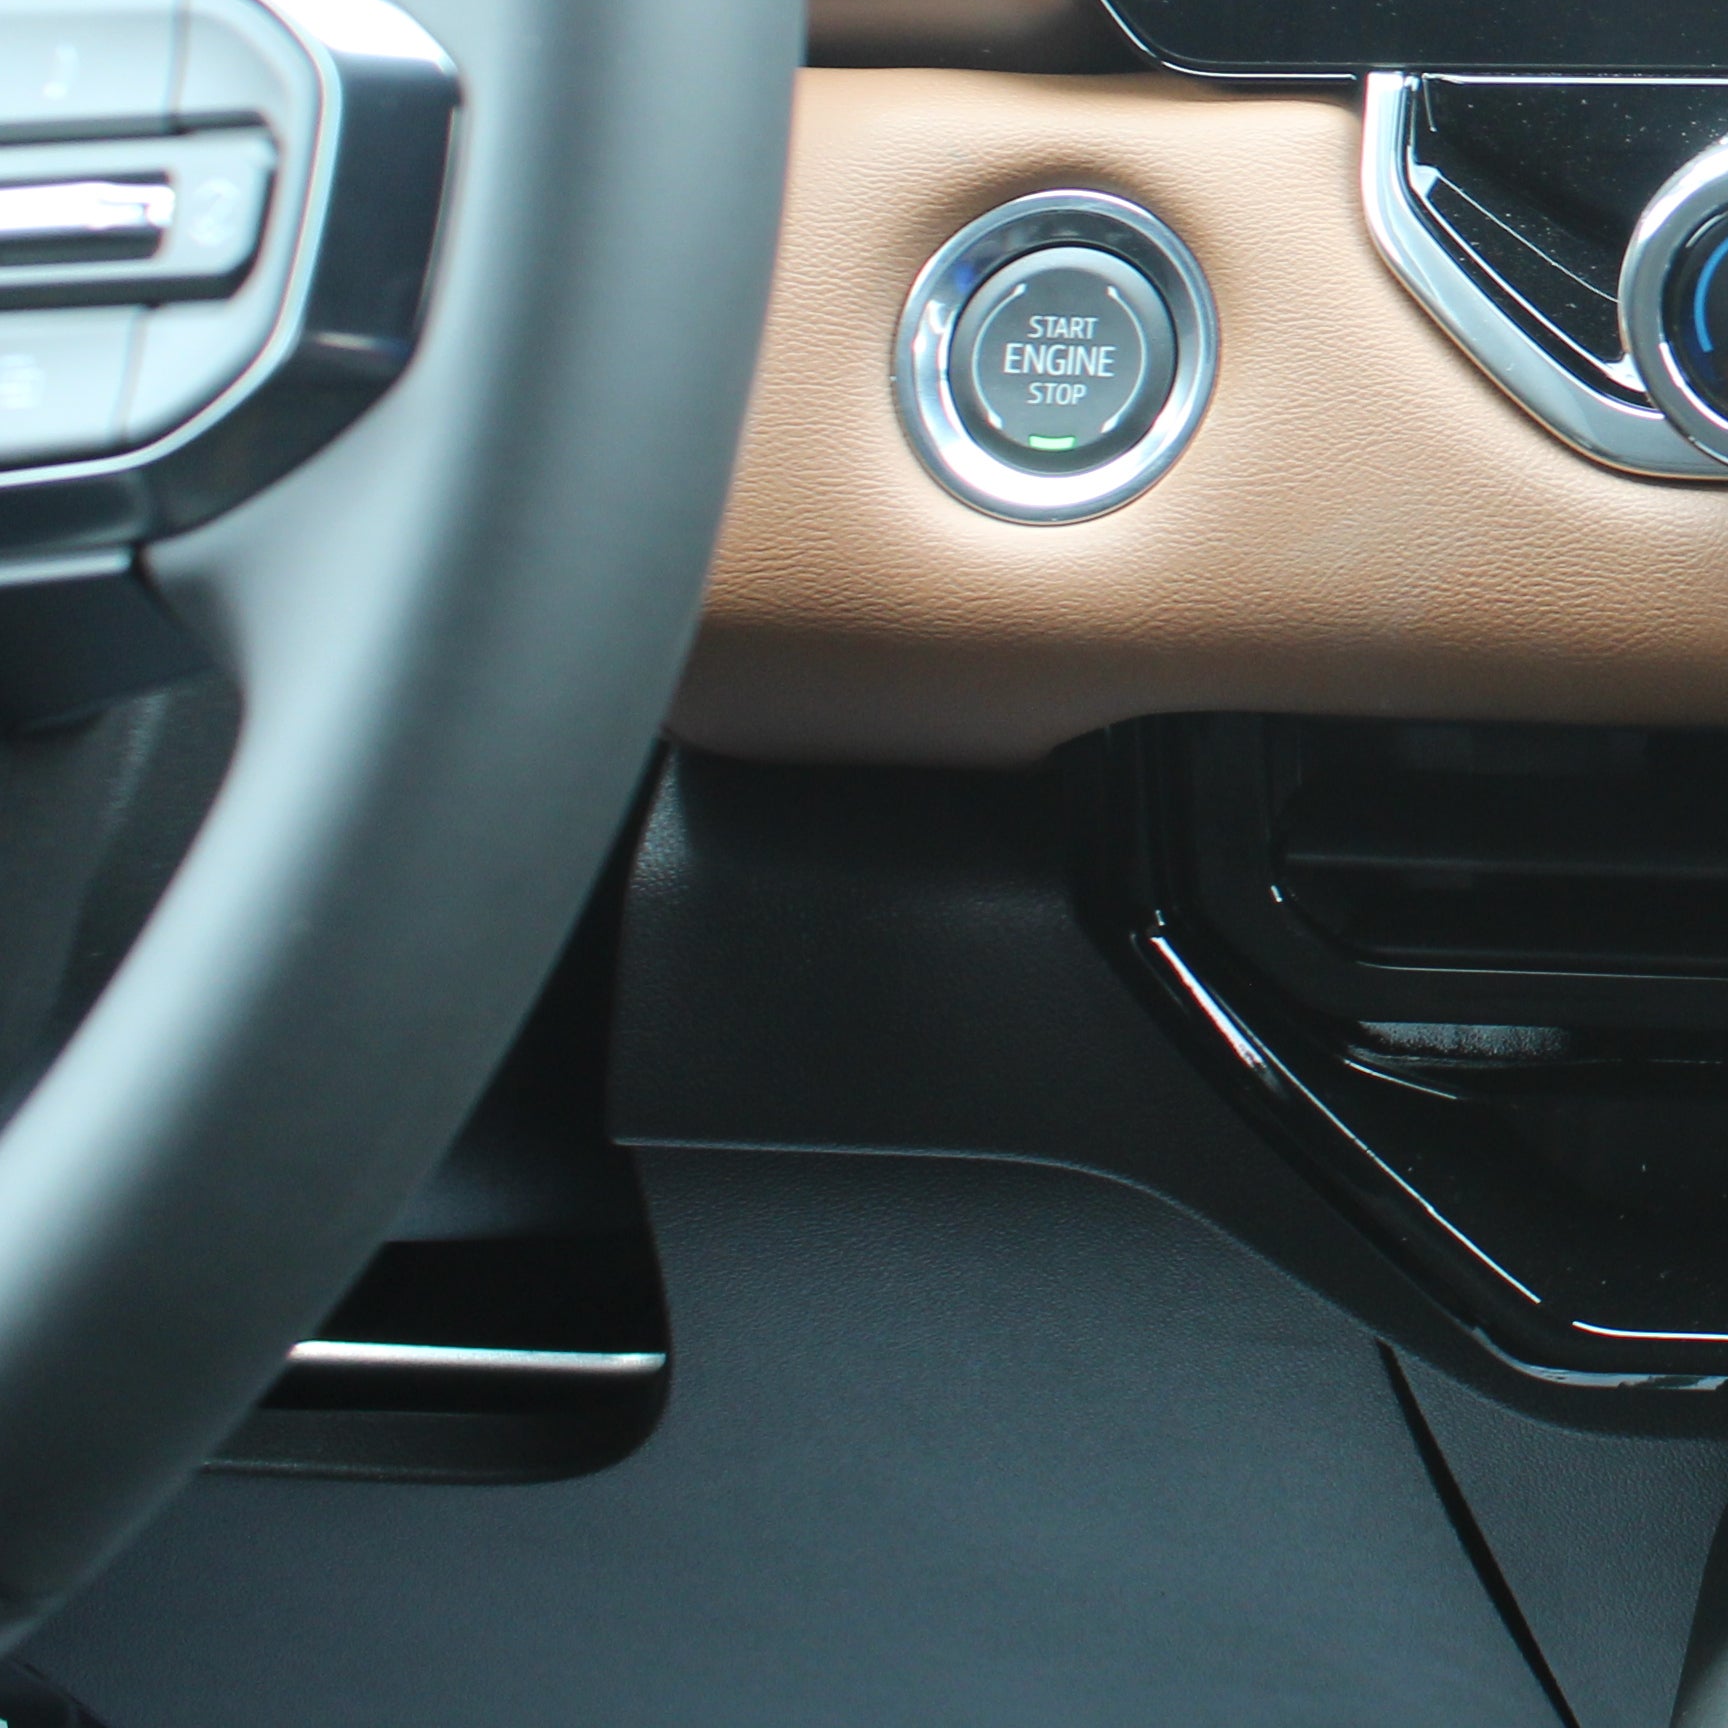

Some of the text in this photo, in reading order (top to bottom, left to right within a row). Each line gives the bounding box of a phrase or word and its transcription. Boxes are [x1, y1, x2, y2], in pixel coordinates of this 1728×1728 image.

[1027, 315, 1099, 339] START
[1003, 342, 1117, 378] ENGINE
[1027, 382, 1087, 405] STOP
